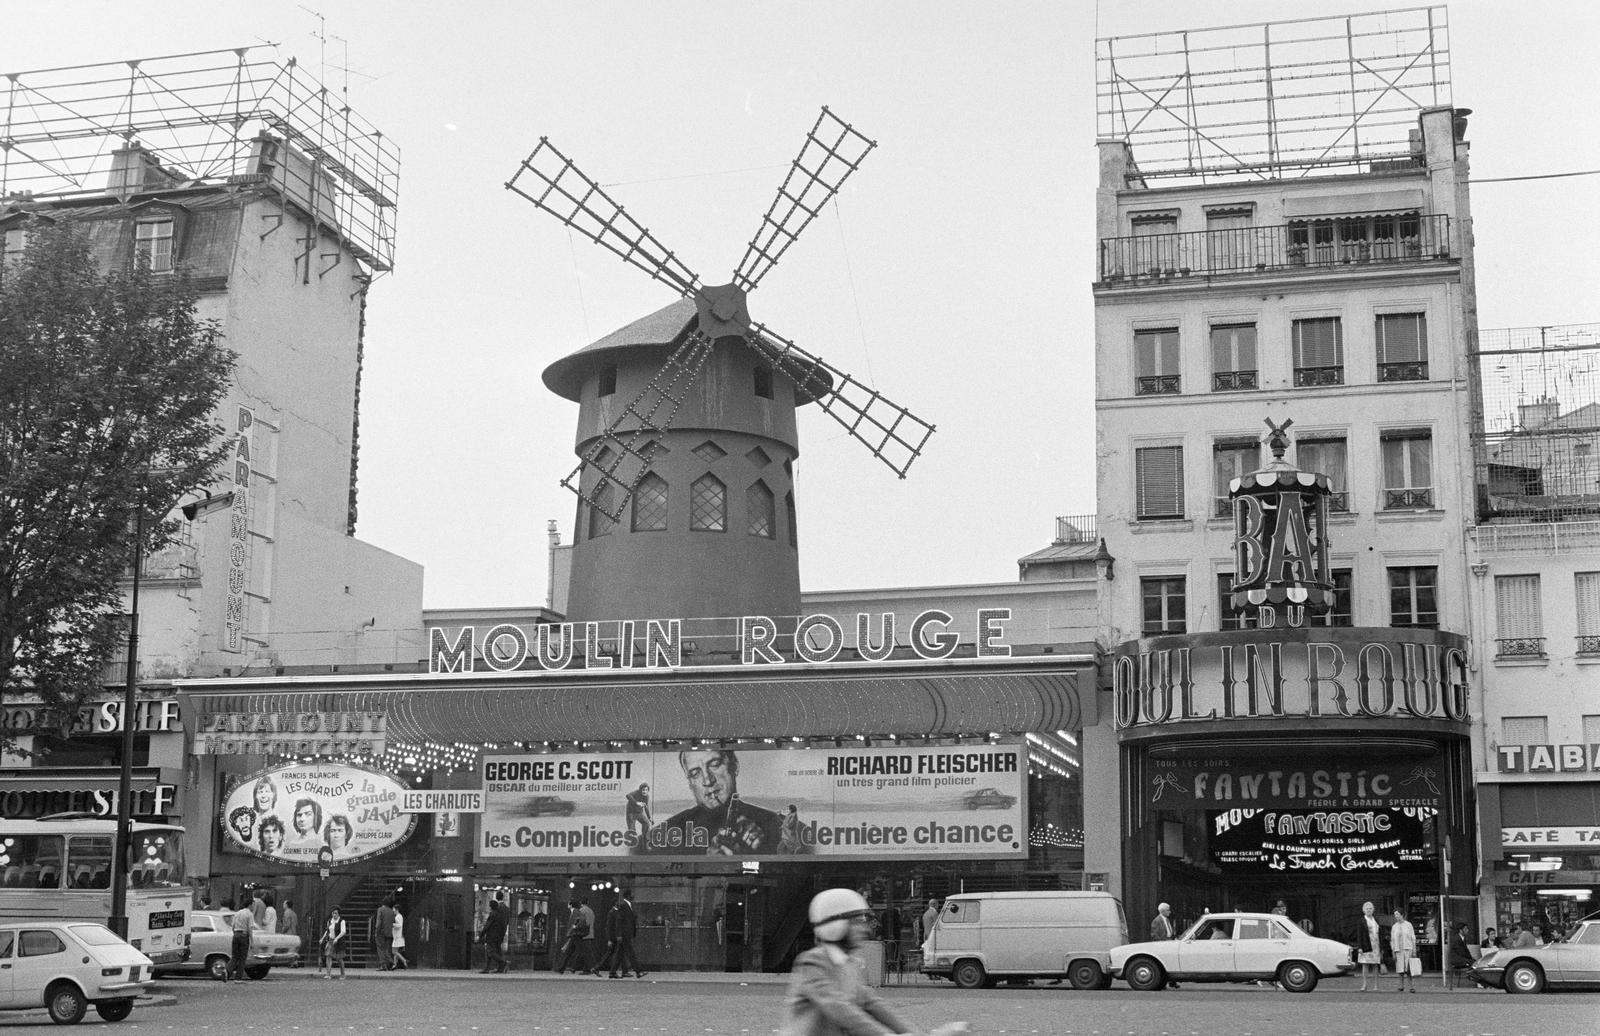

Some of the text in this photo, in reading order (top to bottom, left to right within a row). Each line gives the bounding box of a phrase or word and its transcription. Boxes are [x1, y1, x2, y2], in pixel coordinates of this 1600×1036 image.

[226, 407, 253, 648] PARAMOUNT
[1258, 605, 1304, 628] DU
[429, 608, 1011, 673] MOULIN ROUGE
[1113, 643, 1470, 728] OULIN ROUG
[200, 712, 384, 732] PARAMOUNT
[485, 761, 555, 781] GEORGE
[827, 752, 1017, 776] RICHARD FLEISCHER
[309, 771, 340, 779] BLANCHE
[837, 779, 850, 788] un
[876, 776, 909, 790] grand
[911, 775, 932, 786] film
[934, 776, 976, 788] policier
[285, 780, 354, 797] LES CHARLOTS
[360, 779, 376, 793] la
[528, 782, 541, 793] du
[542, 782, 583, 792] meilleur
[346, 788, 397, 812] grande
[404, 793, 480, 809] LES CHARLOTS
[1353, 799, 1383, 807] GRAND
[1388, 798, 1438, 806] SPECTACLE
[357, 804, 404, 826] JAVA
[1215, 808, 1264, 836] MOU
[484, 831, 511, 848] les
[515, 825, 638, 853] Complices
[651, 821, 684, 848] de
[685, 821, 709, 848] la
[801, 820, 908, 845] dernière
[1286, 845, 1316, 854] DAUPHIN
[1268, 853, 1399, 871] Le French Cancan
